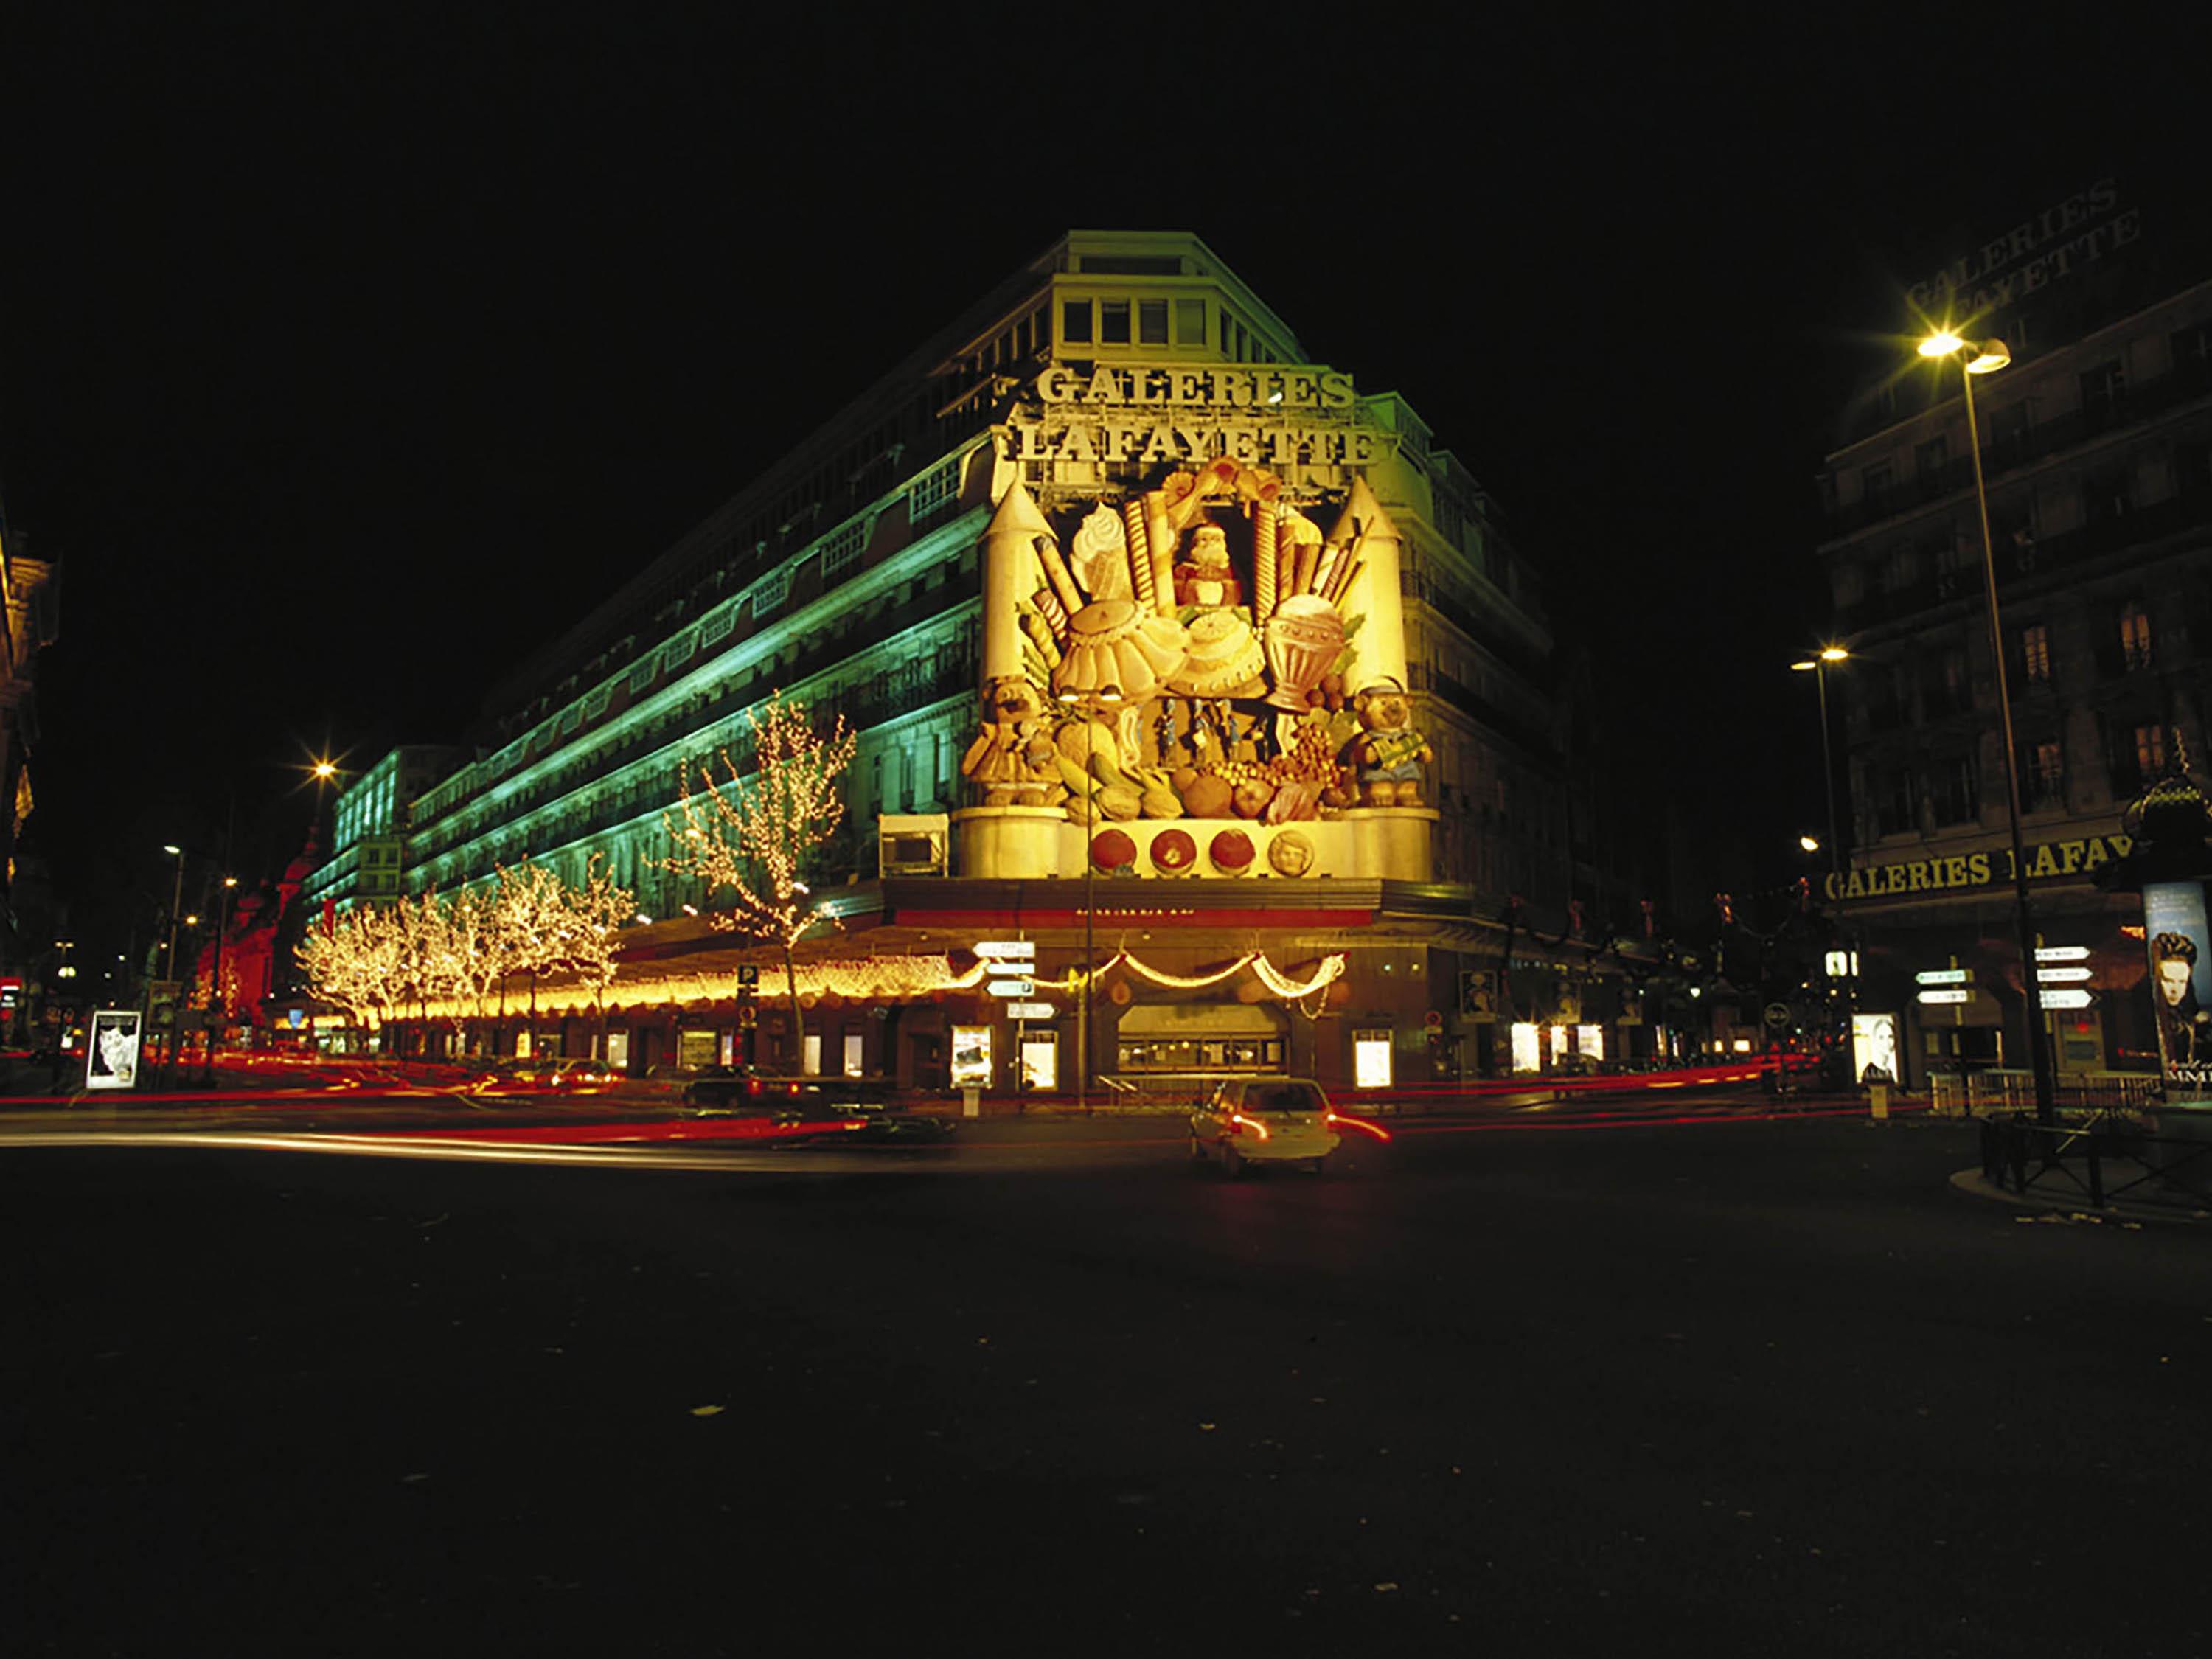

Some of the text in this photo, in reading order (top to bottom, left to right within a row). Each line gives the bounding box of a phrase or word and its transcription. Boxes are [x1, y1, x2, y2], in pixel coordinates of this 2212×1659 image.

[1907, 176, 2118, 308] GALERIES
[1037, 368, 1354, 408] GALERIES
[1017, 423, 1377, 465] LAFAYETTE
[1825, 852, 1990, 900] GALERIES
[2006, 835, 2134, 880] LAFAY
